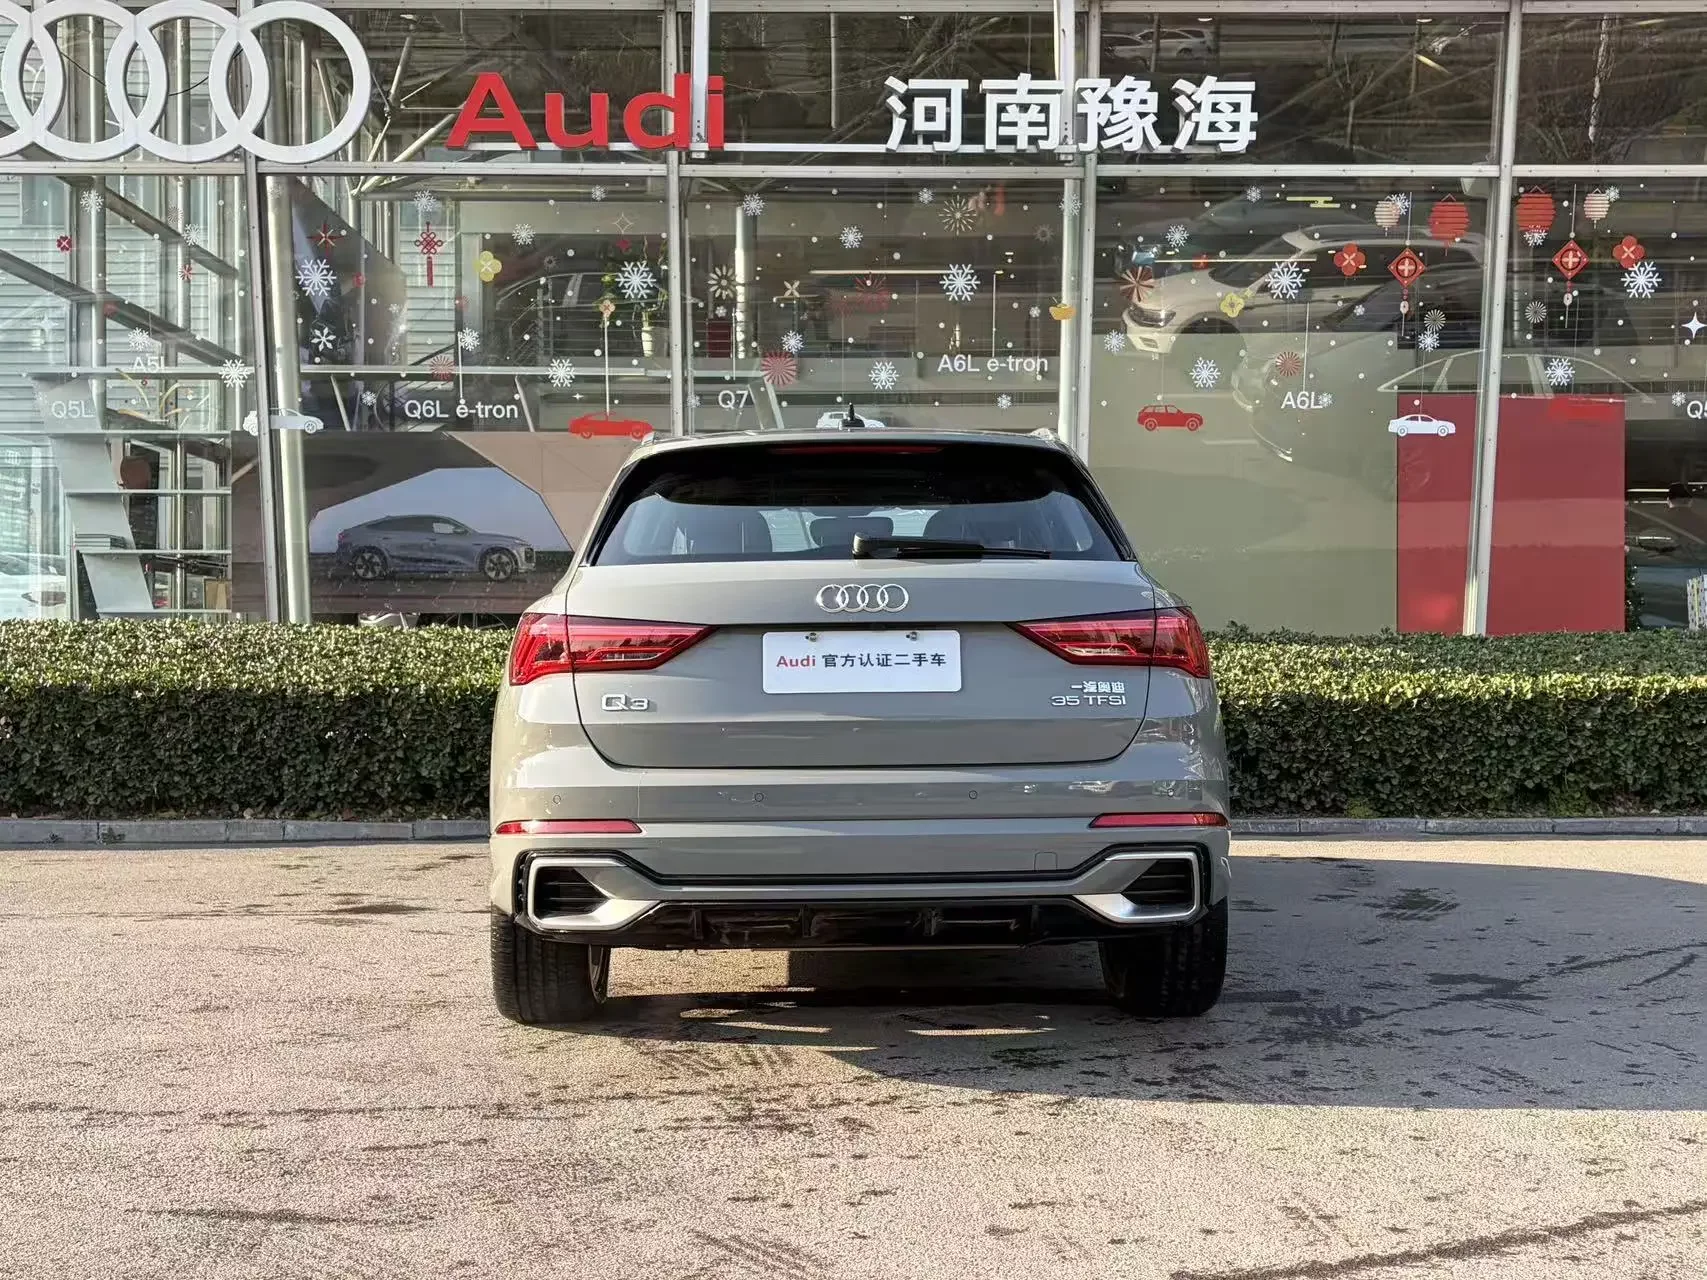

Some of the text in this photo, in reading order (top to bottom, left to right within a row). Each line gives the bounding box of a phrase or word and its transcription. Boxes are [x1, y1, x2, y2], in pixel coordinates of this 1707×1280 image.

[445, 72, 725, 150] Audi
[884, 73, 1259, 153] 河南豫海
[937, 354, 1048, 372] A6L e-tron
[718, 390, 749, 409] Q7
[1280, 391, 1323, 409] A6L
[51, 400, 95, 419] Q5L
[404, 400, 518, 419] Q6L e-tron
[776, 653, 947, 668] Audi 官方认证二手车
[1070, 681, 1125, 693] 一汽奥迪
[601, 694, 649, 711] Q3
[1051, 695, 1126, 706] 35 TFSI
